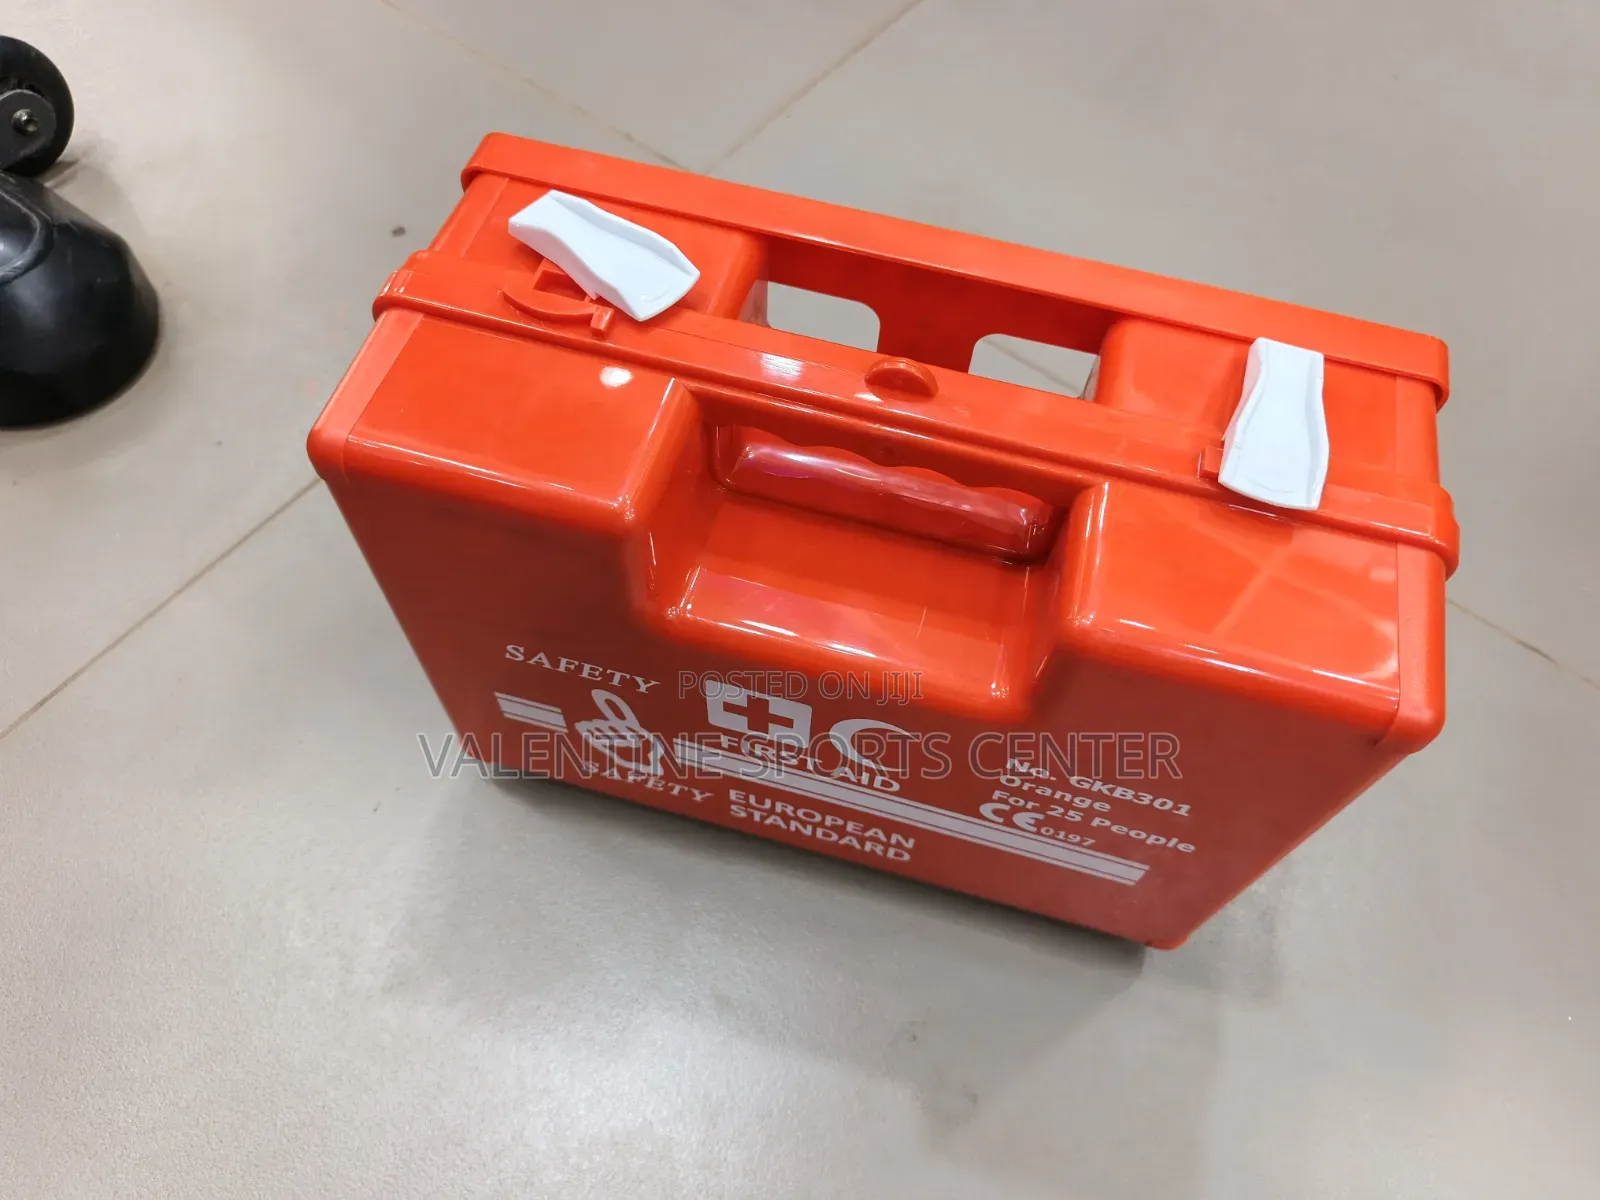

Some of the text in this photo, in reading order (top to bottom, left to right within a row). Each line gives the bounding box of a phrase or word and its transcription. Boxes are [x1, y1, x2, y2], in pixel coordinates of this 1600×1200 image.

[505, 644, 661, 694] SAFETY
[583, 760, 714, 802] SAFETY
[720, 735, 901, 792] FIRST AID
[1006, 757, 1192, 817] No. GKB301
[729, 788, 916, 849] EUROPEAN
[992, 789, 1196, 853] For 25 People
[999, 775, 1112, 812] Orange
[730, 804, 912, 861] STANDARD
[979, 802, 1096, 847] CE 0197
